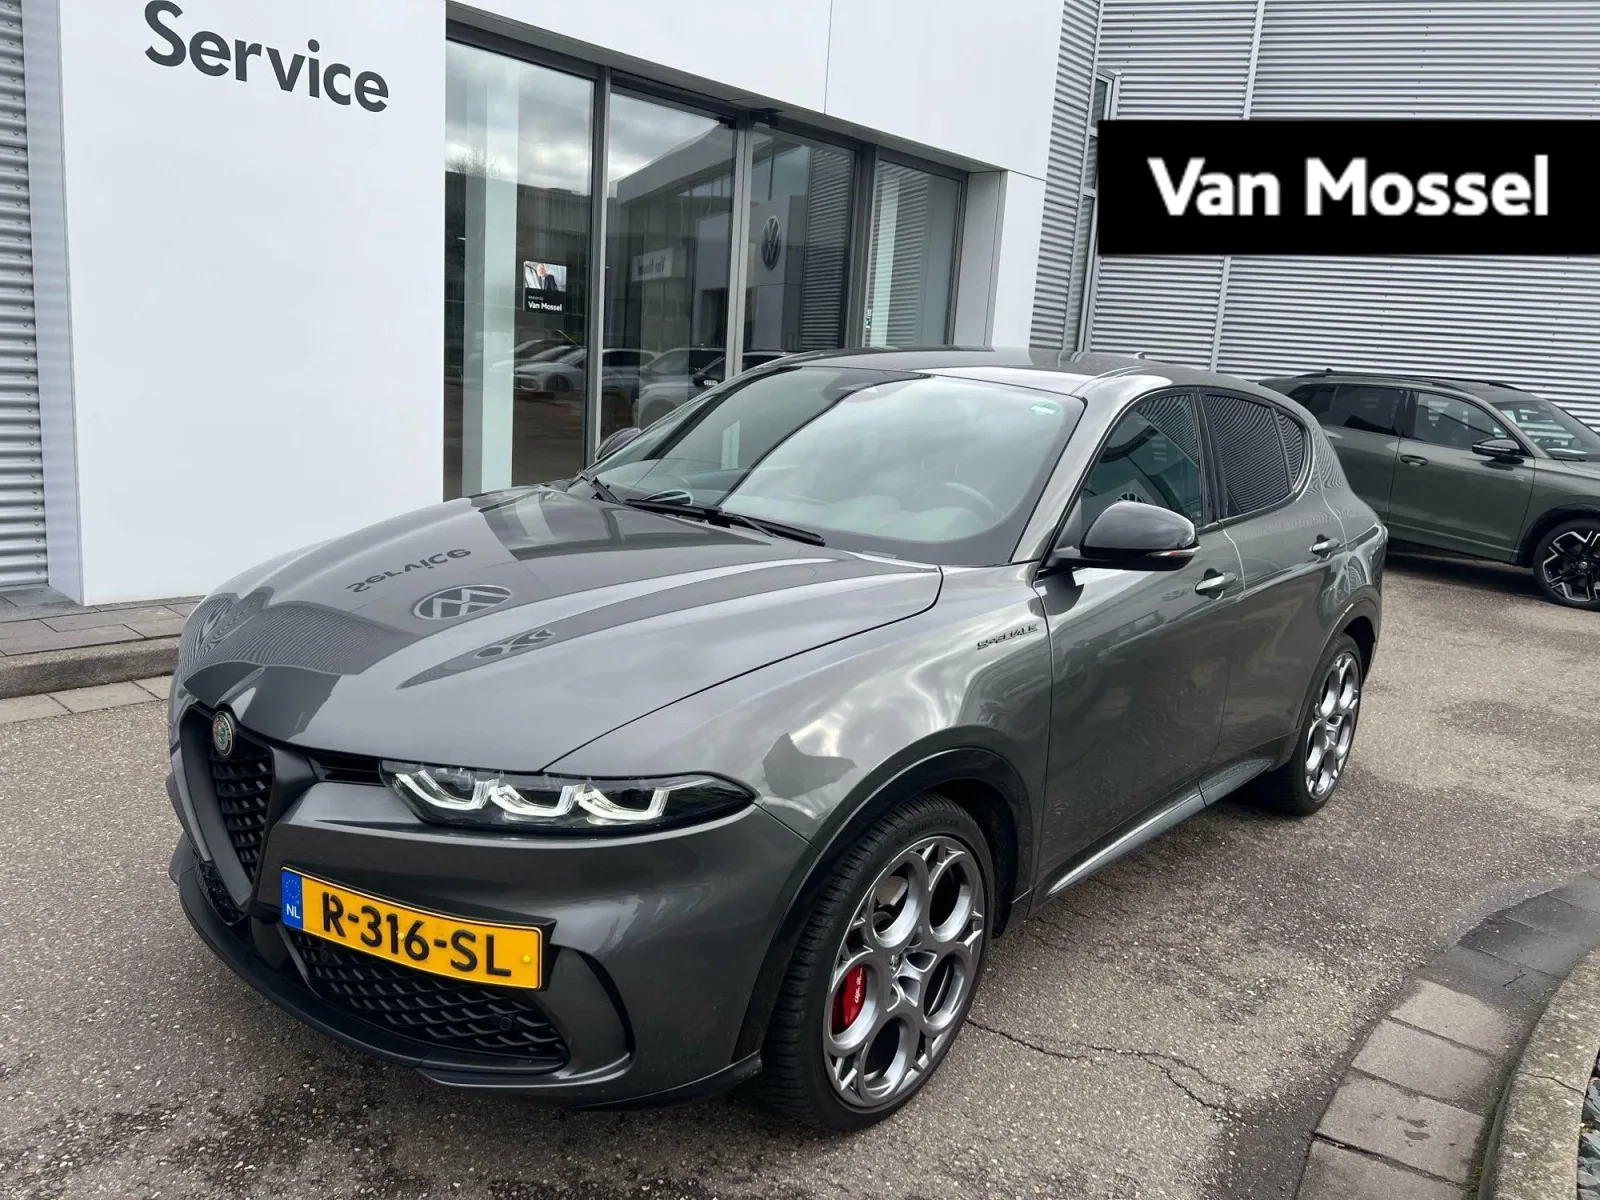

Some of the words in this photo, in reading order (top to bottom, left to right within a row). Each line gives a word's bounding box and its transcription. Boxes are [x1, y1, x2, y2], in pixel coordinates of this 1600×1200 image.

[144, 0, 389, 113] Service
[528, 301, 540, 309] Van
[541, 303, 563, 311] Mossel
[286, 903, 300, 920] NL
[321, 891, 512, 977] R-316-SL
